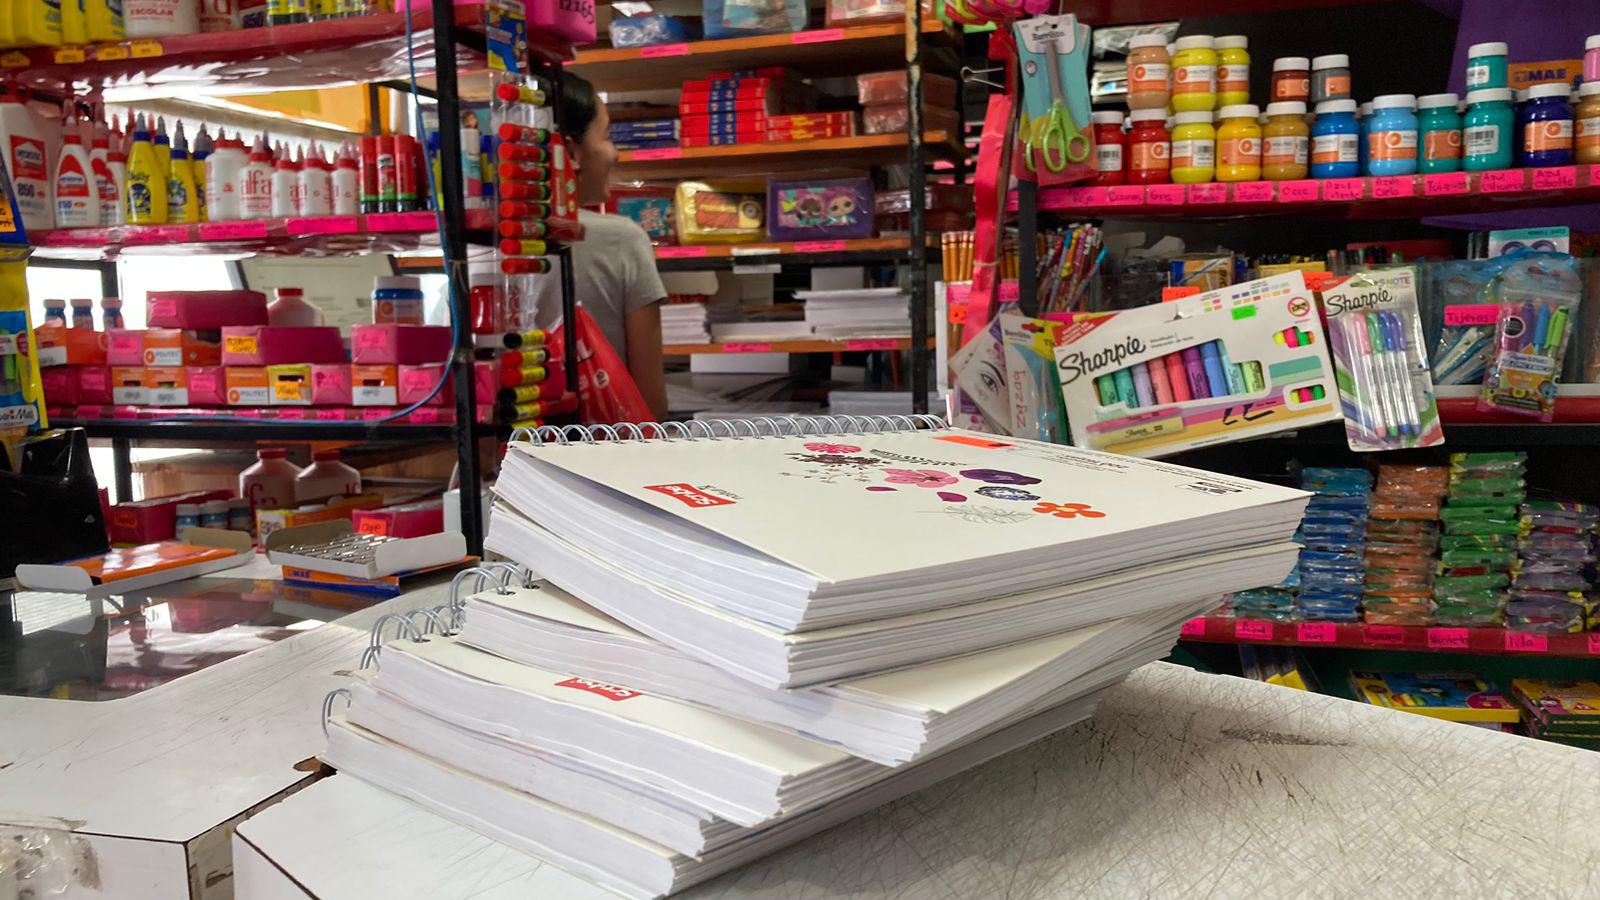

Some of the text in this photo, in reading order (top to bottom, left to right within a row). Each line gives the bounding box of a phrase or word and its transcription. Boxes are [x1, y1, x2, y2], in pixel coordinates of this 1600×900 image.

[1529, 69, 1567, 81] MAE
[1325, 288, 1393, 317] Sharpie
[1446, 313, 1490, 326] Tijeras
[1058, 337, 1147, 386] Sharpie
